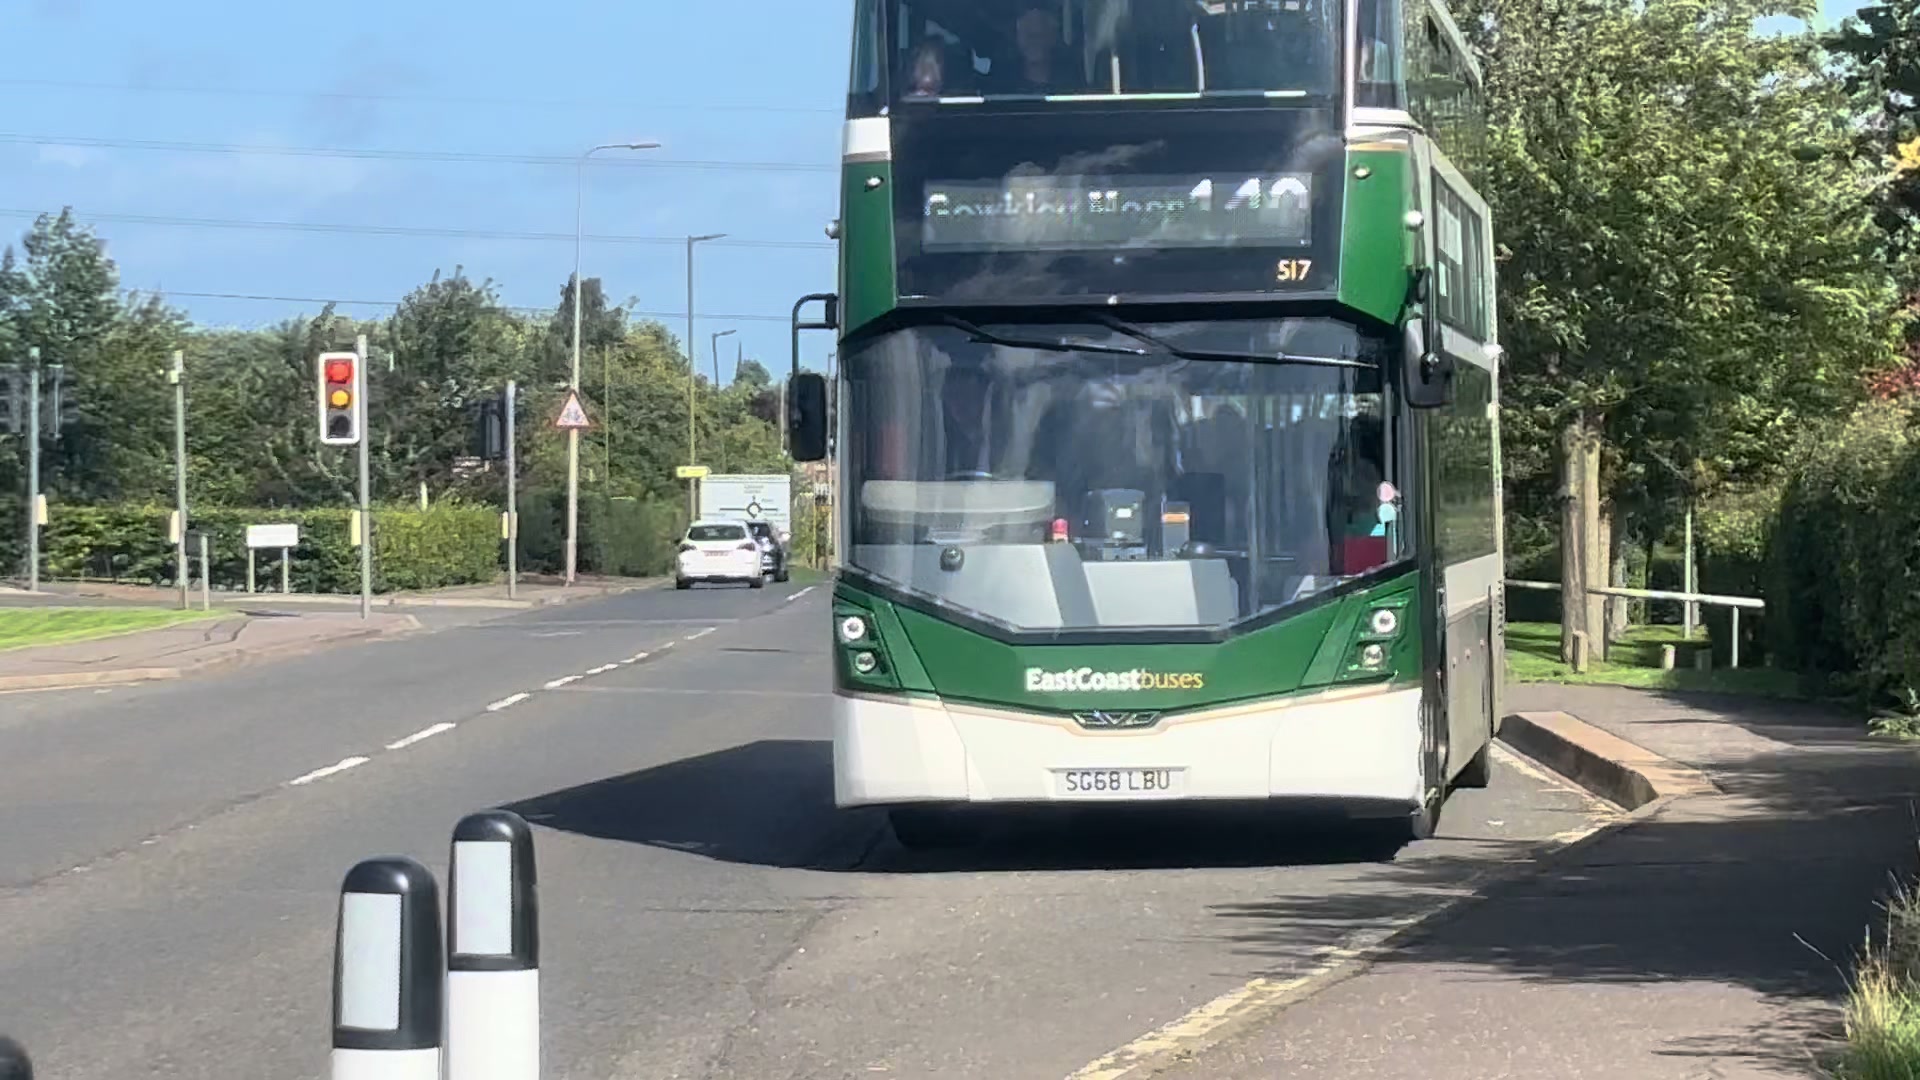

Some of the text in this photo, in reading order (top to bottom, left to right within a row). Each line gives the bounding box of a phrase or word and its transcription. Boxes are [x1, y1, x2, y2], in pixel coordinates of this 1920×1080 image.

[1277, 259, 1312, 281] 517
[1065, 770, 1171, 791] SG68 LBU
